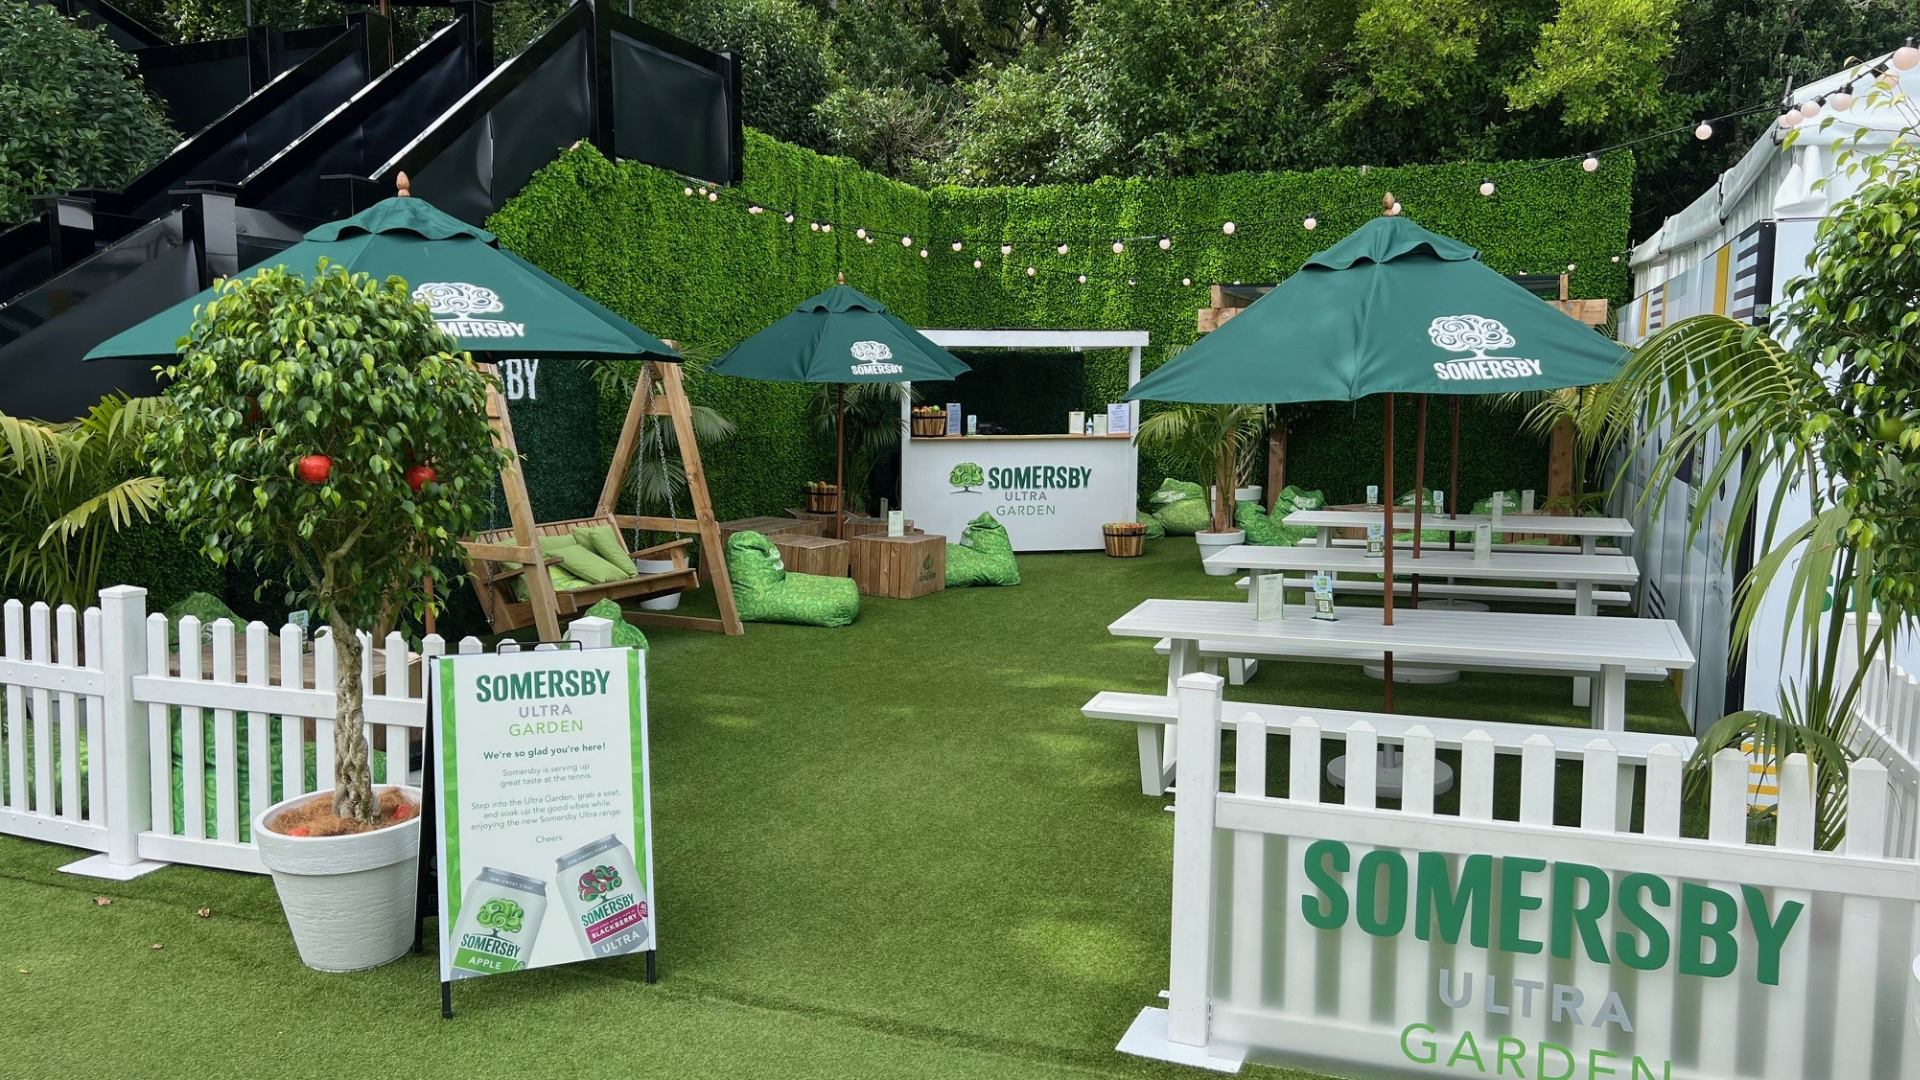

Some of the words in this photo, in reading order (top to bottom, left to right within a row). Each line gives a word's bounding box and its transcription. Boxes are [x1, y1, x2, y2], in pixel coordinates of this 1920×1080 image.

[437, 321, 525, 338] MERSBY
[850, 364, 903, 376] SOMERSBY
[1433, 358, 1543, 380] SOMERSBY
[988, 465, 1092, 490] SOMERSBY
[1005, 491, 1047, 501] ULTRA
[996, 504, 1056, 516] GARDEN
[476, 669, 610, 703] SOMERSBY
[519, 704, 572, 718] ULTRA
[509, 719, 583, 736] GARDEN
[484, 749, 512, 760] We're
[514, 749, 525, 758] so
[528, 747, 548, 758] glad
[550, 745, 579, 757] you're
[582, 742, 605, 752] here!
[500, 778, 521, 788] great
[523, 776, 542, 785] taste
[553, 773, 566, 782] the
[568, 772, 592, 781] tennis.
[503, 767, 541, 779] Somersby
[550, 764, 578, 774] serving
[580, 763, 590, 771] up
[471, 801, 490, 811] Step
[492, 799, 507, 808] into
[509, 798, 522, 806] the
[524, 795, 543, 805] Ultra
[545, 793, 575, 804] Garden,
[577, 790, 595, 802] grab
[603, 789, 621, 798] seat,
[484, 810, 498, 819] and
[500, 807, 518, 817] soak
[520, 808, 531, 816] up
[533, 805, 545, 814] the
[547, 803, 568, 815] good
[570, 801, 589, 810] vibes
[591, 798, 610, 808] while
[471, 819, 505, 831] enjoying
[507, 818, 520, 827] the
[521, 817, 538, 825] new
[540, 812, 577, 824] Somersby
[579, 809, 597, 819] Ultra
[599, 809, 622, 819] range.
[536, 834, 563, 843] Cheers
[581, 893, 635, 927] SOMERSBY
[1301, 839, 1804, 986] SOMERSBY
[591, 912, 637, 939] BLACKBERRY
[461, 933, 521, 958] SOMERSBY
[601, 929, 640, 954] ULTRA
[468, 956, 502, 970] APPLE
[1438, 966, 1634, 1033] ULTRA
[1400, 1022, 1672, 1080] GARDEN
